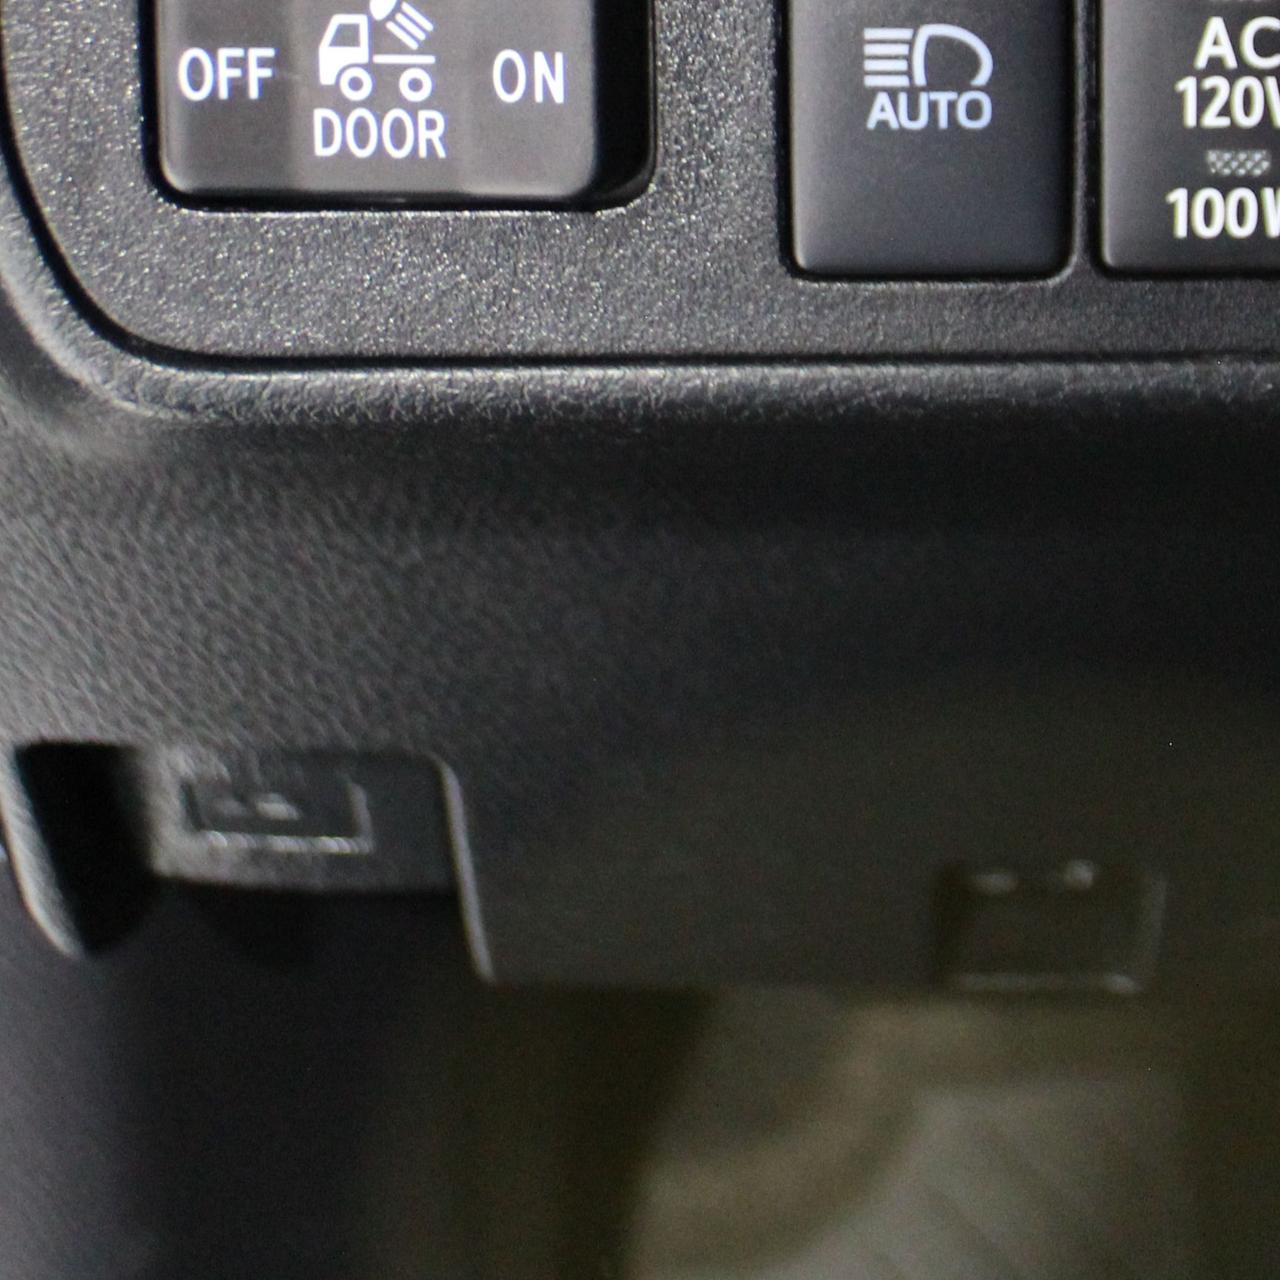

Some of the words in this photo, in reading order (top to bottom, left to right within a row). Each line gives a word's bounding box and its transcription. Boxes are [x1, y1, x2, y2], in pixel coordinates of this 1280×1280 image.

[177, 47, 275, 101] OFF
[492, 50, 564, 104] ON
[314, 109, 446, 158] DOOR
[866, 91, 992, 129] AUTO
